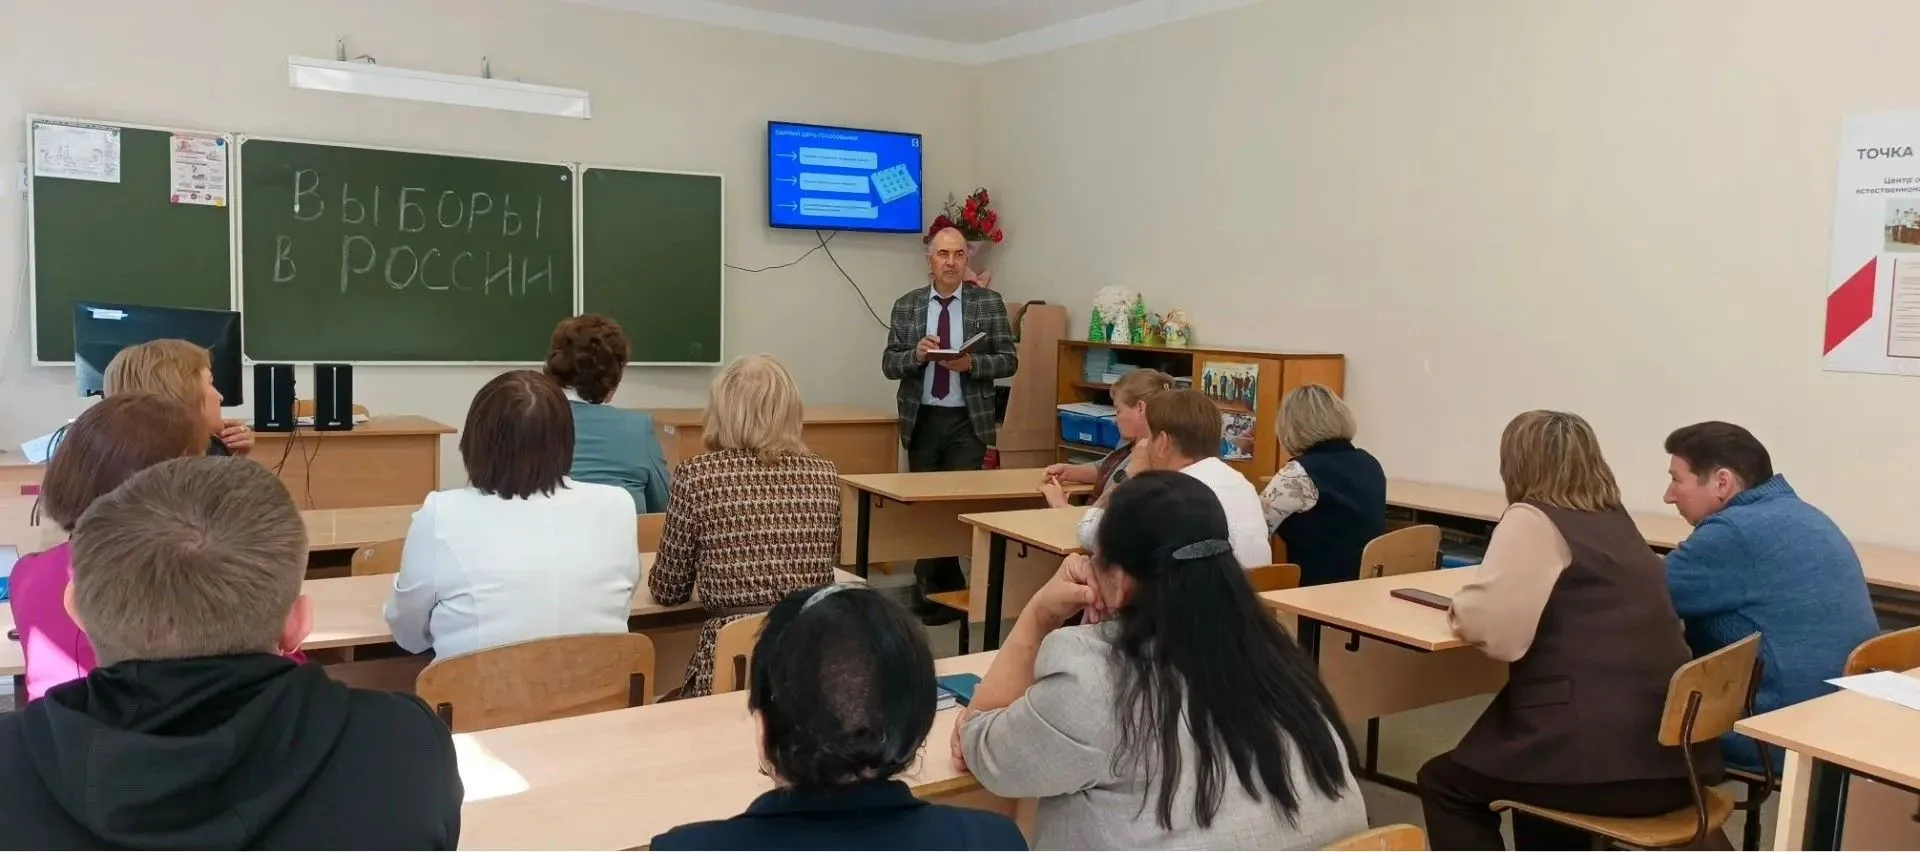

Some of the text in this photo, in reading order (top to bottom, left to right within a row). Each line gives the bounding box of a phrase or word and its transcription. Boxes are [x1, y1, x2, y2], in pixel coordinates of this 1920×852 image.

[1856, 146, 1914, 160] ТОЧКА
[1883, 177, 1913, 185] Центр
[294, 169, 543, 239] ВЫБОРЫ
[340, 235, 552, 296] РОССИИ
